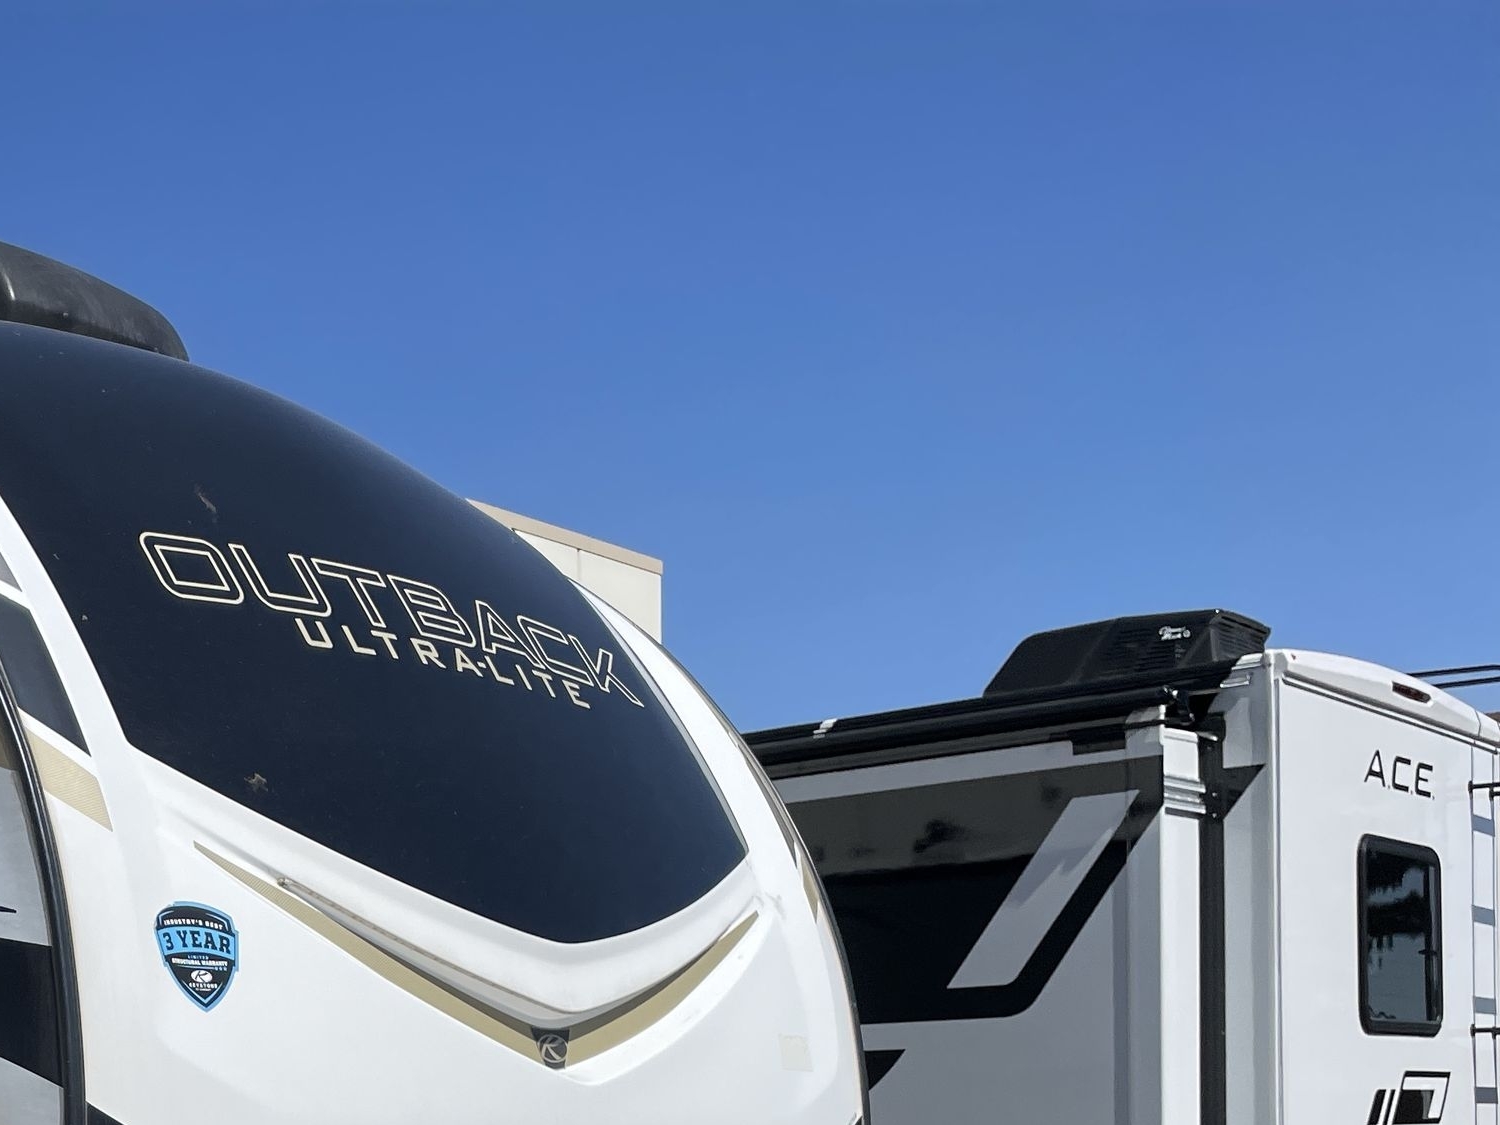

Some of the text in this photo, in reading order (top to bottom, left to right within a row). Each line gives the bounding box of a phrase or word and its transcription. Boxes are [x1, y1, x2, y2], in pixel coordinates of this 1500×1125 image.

[140, 531, 645, 707] OUTBACK
[295, 617, 591, 709] ULTRA-LITE
[162, 930, 231, 954] 3 YEAR
